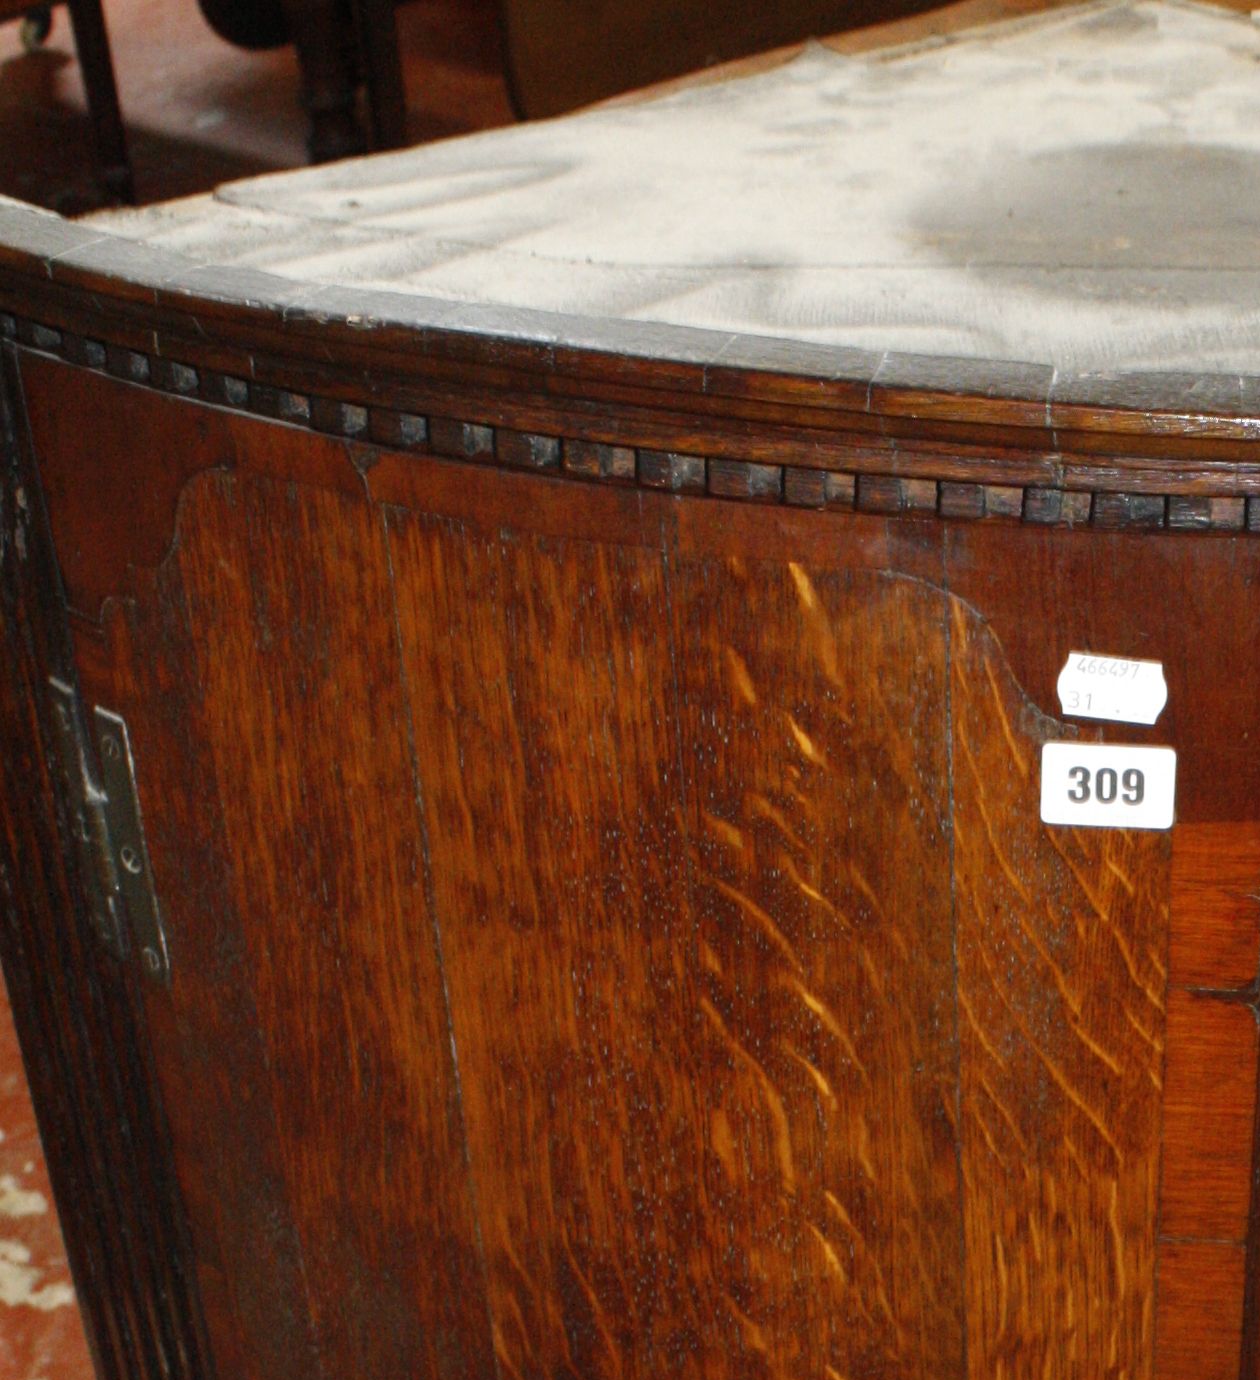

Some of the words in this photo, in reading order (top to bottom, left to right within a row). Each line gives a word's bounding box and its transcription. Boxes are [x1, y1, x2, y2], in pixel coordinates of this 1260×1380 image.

[1076, 657, 1140, 679] 466497
[1067, 690, 1092, 711] 31
[1067, 765, 1145, 806] 309
